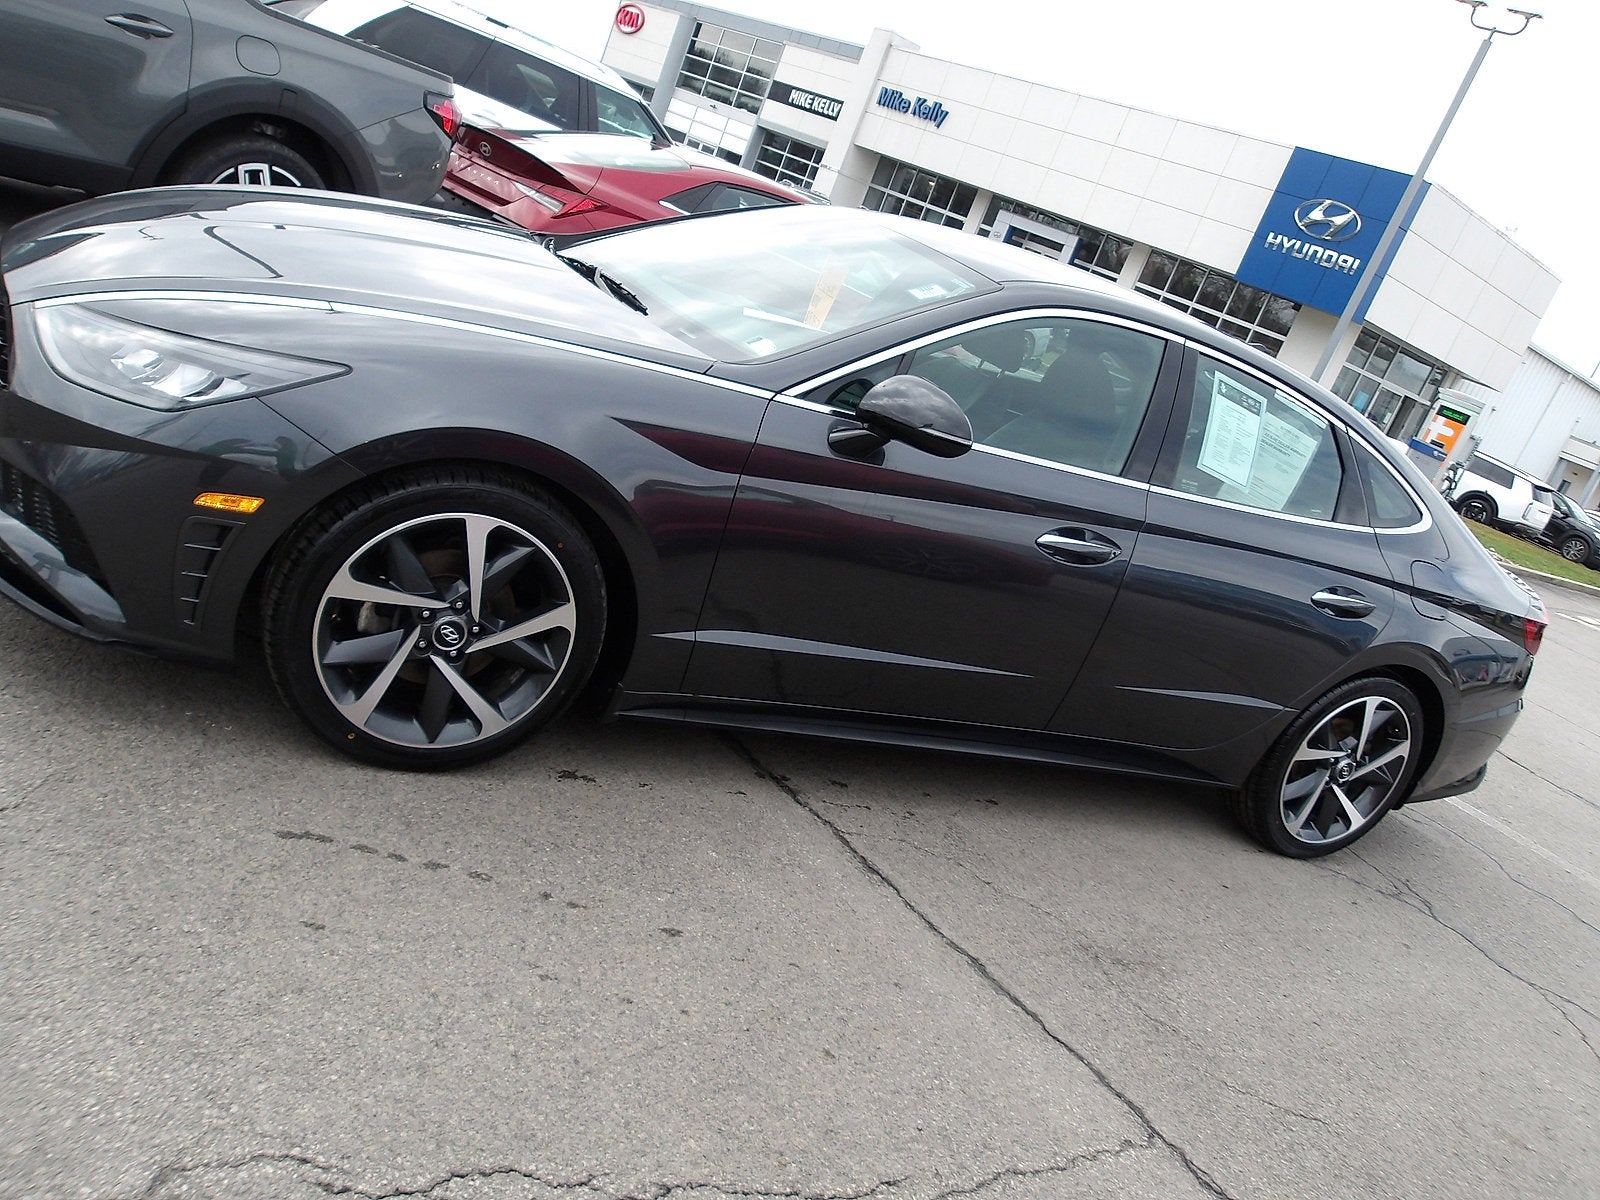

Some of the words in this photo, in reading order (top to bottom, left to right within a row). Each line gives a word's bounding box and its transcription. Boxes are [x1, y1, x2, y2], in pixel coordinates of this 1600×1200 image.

[616, 7, 641, 30] KIA
[788, 89, 813, 110] MIKE
[812, 96, 843, 118] KELLY
[876, 86, 911, 114] Mike
[910, 96, 949, 129] Kelly
[1264, 231, 1360, 275] HYUNDAI
